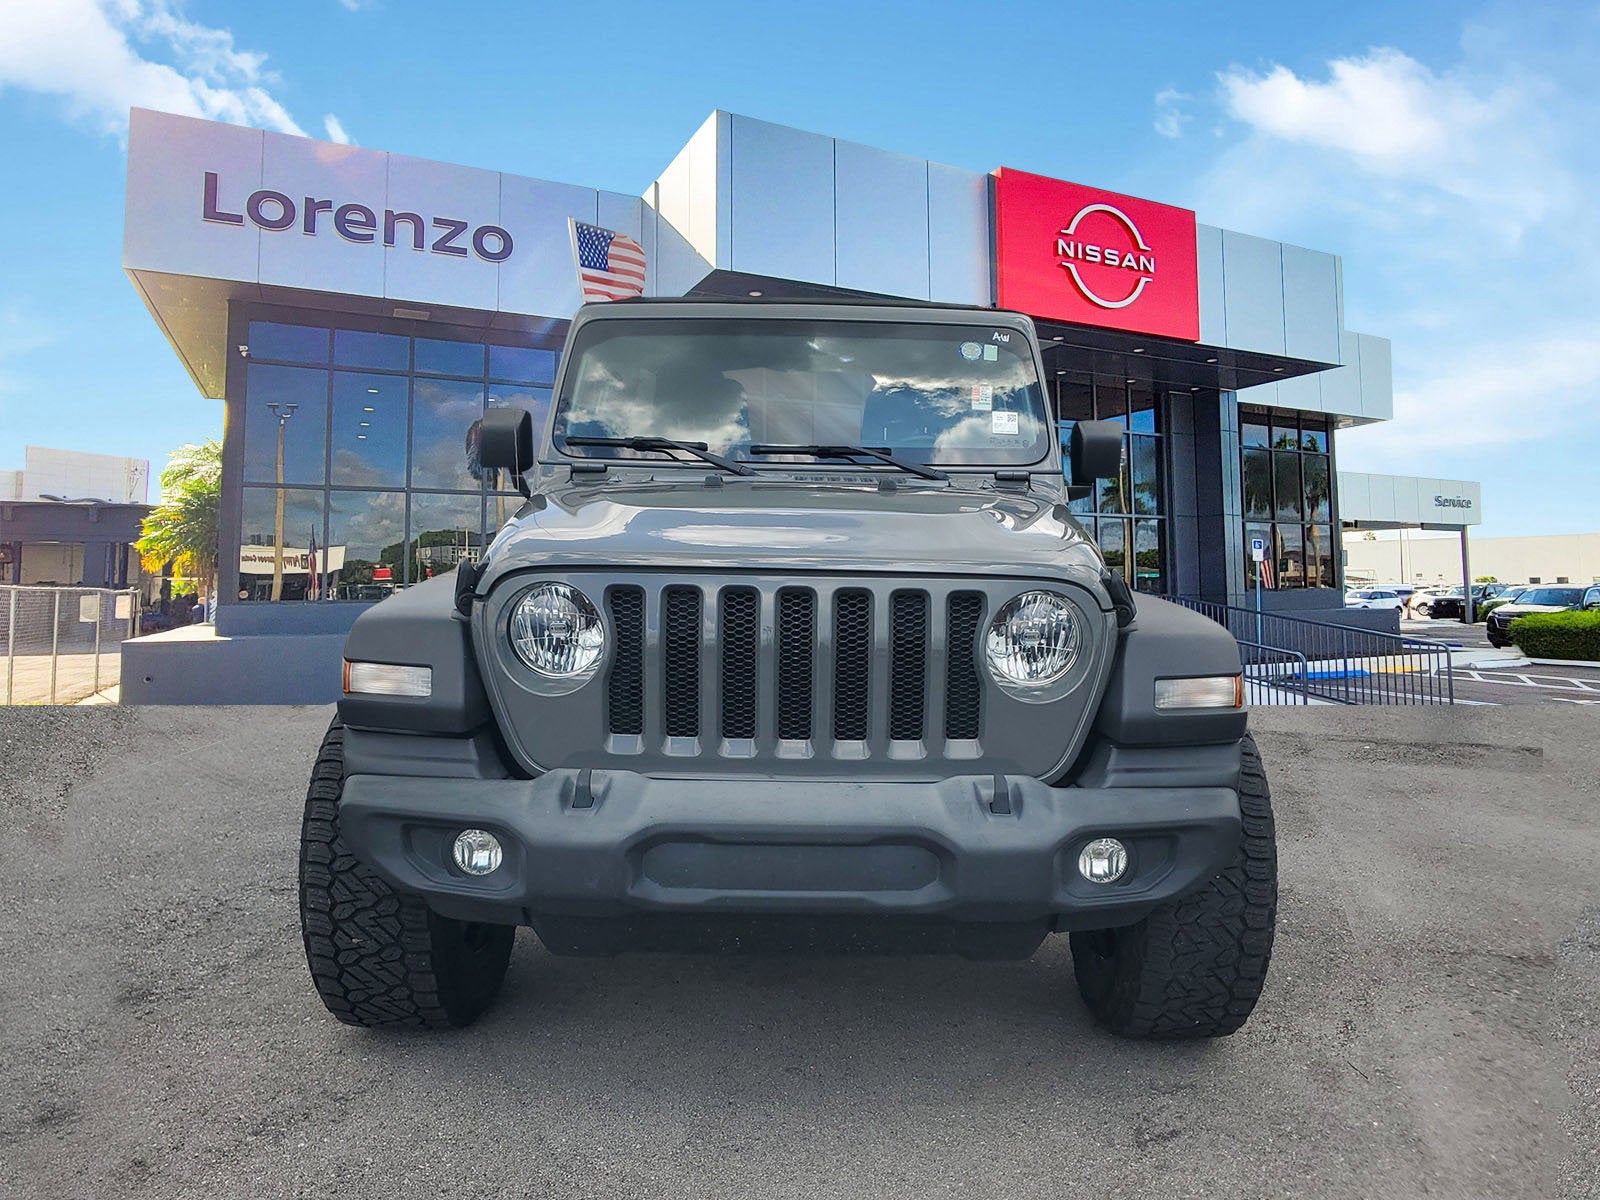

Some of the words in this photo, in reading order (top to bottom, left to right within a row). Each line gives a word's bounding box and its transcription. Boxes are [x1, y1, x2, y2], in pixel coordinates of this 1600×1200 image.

[202, 170, 514, 263] Lorenzo
[1056, 238, 1155, 273] NISSAN
[1434, 495, 1472, 508] Service
